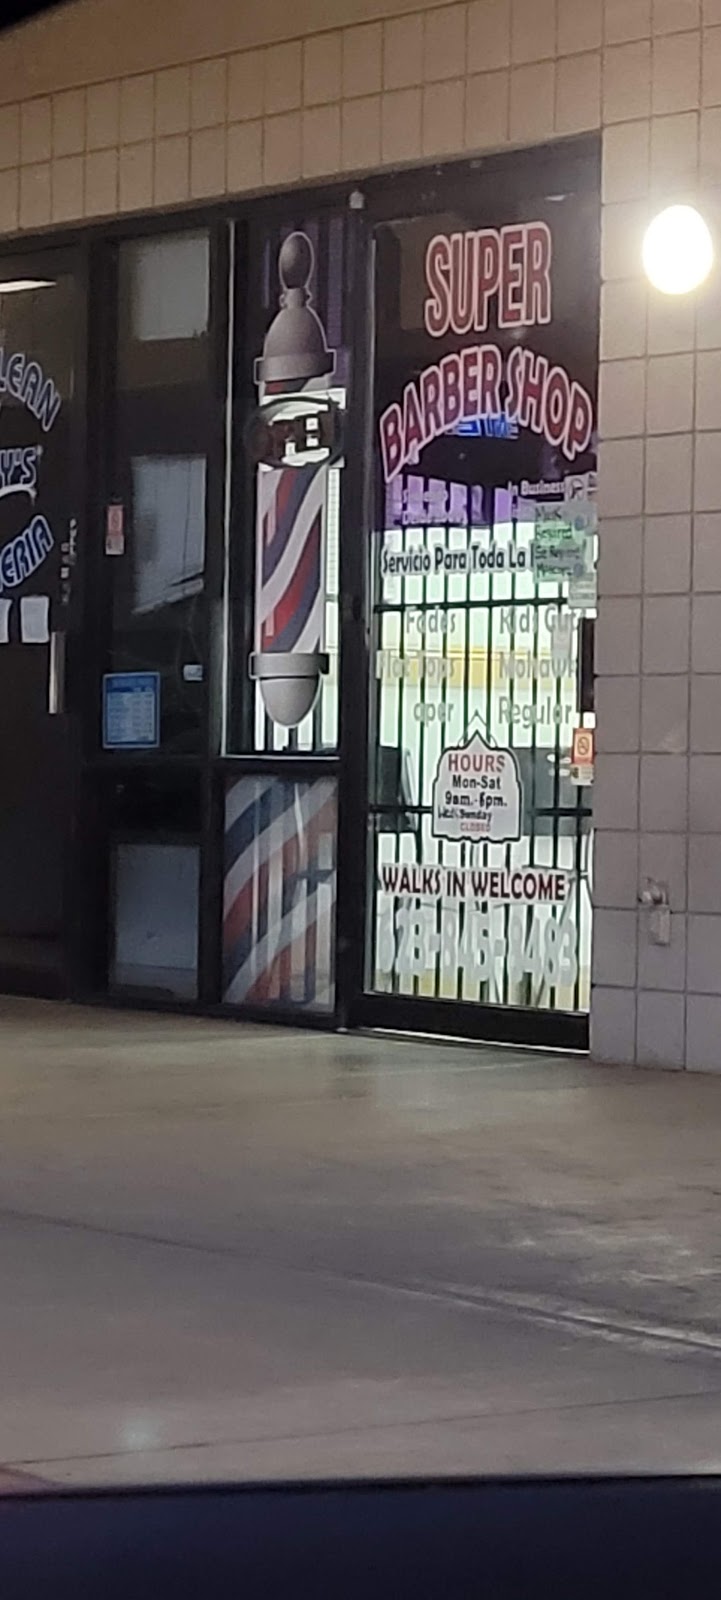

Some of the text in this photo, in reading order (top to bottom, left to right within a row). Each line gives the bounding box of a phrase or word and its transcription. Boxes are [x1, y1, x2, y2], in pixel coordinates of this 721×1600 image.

[425, 221, 551, 338] SUPER
[380, 344, 593, 484] BARBER SHOP
[382, 548, 431, 574] Servicio
[435, 546, 467, 570] Para
[471, 545, 505, 569] Toda
[509, 542, 526, 569] La
[406, 606, 456, 634] Fades
[499, 696, 573, 729] Regular
[448, 754, 505, 773] HOURS
[452, 774, 501, 790] Mon-Sat
[382, 866, 565, 901] WALKS IN WELCOME
